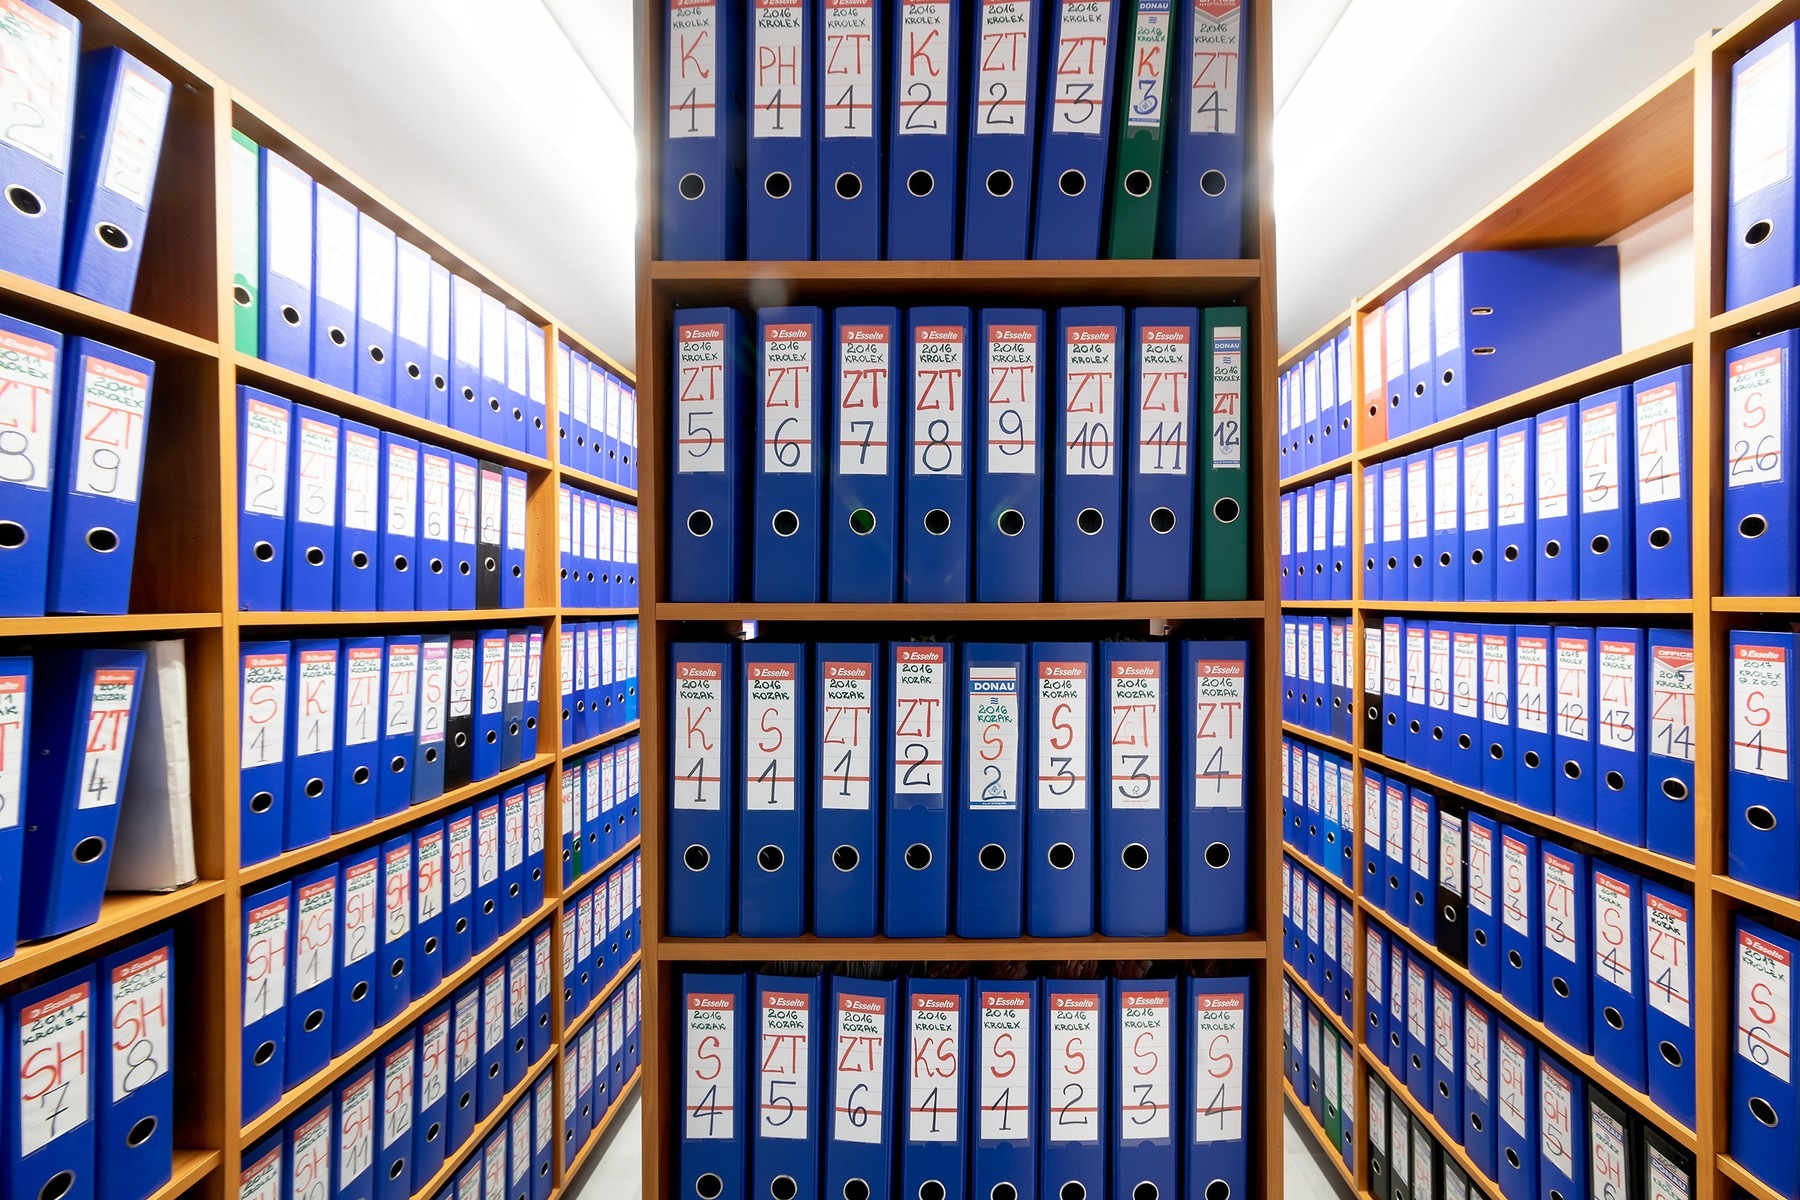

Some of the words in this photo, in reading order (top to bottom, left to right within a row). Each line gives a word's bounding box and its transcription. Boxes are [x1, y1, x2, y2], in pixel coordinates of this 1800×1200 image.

[759, 19, 800, 28] KROLEX
[763, 8, 792, 18] 2016
[987, 14, 1024, 24] KROLEX
[988, 4, 1015, 14] 2016
[1140, 2, 1169, 10] DONAU
[1138, 26, 1162, 36] 2016
[681, 30, 709, 79] K
[759, 46, 796, 86] PH
[827, 34, 870, 74] ZT
[910, 30, 940, 76] K
[982, 32, 1026, 71] ZT
[1058, 37, 1106, 74] ZT
[1138, 46, 1160, 77] K
[1192, 52, 1237, 90] ZT
[679, 87, 698, 132] 1
[766, 89, 784, 130] 1
[837, 84, 856, 129] 1
[906, 82, 937, 130] 2
[986, 82, 1014, 124] 2
[1064, 84, 1094, 124] 3
[1133, 80, 1158, 114] 3
[1198, 90, 1228, 132] 4
[847, 343, 878, 354] 2016
[855, 331, 883, 340] Esselte
[844, 354, 884, 363] KROLEX
[1214, 366, 1238, 374] 2016
[680, 365, 722, 401] ZT
[766, 366, 808, 408] ZT
[842, 368, 887, 408] ZT
[917, 369, 961, 411] ZT
[989, 366, 1034, 404] ZT
[1067, 372, 1112, 414] ZT
[1142, 372, 1187, 412] ZT
[1214, 374, 1240, 382] KROLEX
[87, 388, 144, 408] KROLEX
[1213, 392, 1239, 414] ZT
[1744, 392, 1766, 428] S
[85, 401, 142, 449] ZT
[688, 412, 713, 457] 5
[774, 418, 800, 467] 6
[850, 421, 874, 464] 7
[999, 409, 1024, 455] 9
[1213, 420, 1239, 446] 12
[1640, 417, 1675, 456] ZT
[0, 431, 34, 482] 8
[248, 432, 287, 472] ZT
[922, 419, 952, 471] 8
[1070, 422, 1109, 469] 10
[1146, 422, 1182, 469] 11
[1732, 435, 1778, 475] 26
[89, 449, 120, 493] 9
[1646, 456, 1670, 494] 4
[252, 474, 277, 511] 2
[902, 664, 932, 673] 2016
[910, 652, 938, 661] Esselte
[1484, 659, 1506, 684] ZT
[1748, 651, 1779, 659] Esselte
[306, 680, 327, 716] K
[427, 674, 440, 703] S
[901, 675, 932, 684] KOZAK
[974, 682, 1015, 691] DONAU
[1602, 674, 1632, 706] ZT
[249, 685, 277, 724] S
[426, 706, 438, 730] 2
[896, 698, 940, 738] ZT
[977, 714, 1012, 722] KOZAK
[978, 705, 1008, 714] 2016
[1197, 702, 1242, 739] ZT
[1485, 692, 1508, 720] 10
[1652, 691, 1694, 725] ZT
[1744, 691, 1771, 726] S
[86, 710, 129, 752] ZT
[250, 726, 268, 762] 1
[308, 719, 320, 752] 1
[687, 706, 713, 750] K
[759, 708, 783, 752] S
[824, 706, 871, 746] ZT
[980, 724, 1004, 760] S
[1050, 703, 1074, 750] S
[1112, 704, 1156, 748] ZT
[1603, 710, 1634, 742] 13
[1658, 724, 1695, 758] 14
[903, 744, 931, 786] 2
[1747, 730, 1763, 770] 1
[88, 759, 107, 801] 4
[687, 758, 706, 802] 1
[758, 759, 778, 804] 1
[834, 750, 851, 796] 1
[982, 765, 1008, 801] 2
[1048, 757, 1076, 795] 3
[1118, 754, 1151, 799] 3
[1203, 746, 1230, 793] 4
[419, 856, 441, 892] SH
[450, 838, 471, 873] SH
[453, 871, 466, 897] 5
[1507, 865, 1521, 893] S
[347, 888, 375, 929] SH
[422, 895, 435, 918] 4
[1508, 894, 1522, 921] 3
[1547, 880, 1574, 917] ZT
[1657, 903, 1682, 918] Esselte
[299, 909, 332, 955] KS
[351, 926, 367, 961] 2
[1551, 917, 1565, 942] 3
[1602, 908, 1623, 945] S
[247, 930, 286, 981] SH
[1649, 926, 1685, 966] ZT
[1752, 942, 1784, 960] Esselte
[120, 966, 156, 989] 2011
[306, 949, 320, 983] 1
[1602, 948, 1624, 983] 4
[114, 972, 167, 999] KROLEX
[255, 978, 270, 1017] 1
[776, 998, 804, 1007] Esselte
[1656, 967, 1679, 1003] 4
[1748, 983, 1776, 1024] S
[23, 1011, 88, 1045] KROLEX
[32, 1006, 74, 1032] 2011
[113, 988, 165, 1051] SH
[768, 1009, 798, 1019] 2016
[768, 1020, 804, 1028] KOZAK
[695, 1036, 722, 1080] S
[762, 1034, 806, 1074] ZT
[838, 1036, 882, 1072] ZT
[914, 1037, 957, 1078] KS
[991, 1032, 1016, 1078] S
[1064, 1037, 1085, 1075] S
[1133, 1032, 1158, 1076] S
[1208, 1034, 1233, 1078] S
[1748, 1027, 1771, 1065] 6
[22, 1030, 84, 1101] SH
[123, 1039, 158, 1093] 8
[41, 1082, 70, 1137] 7
[386, 1068, 412, 1114] SH
[692, 1084, 723, 1136] 4
[766, 1080, 796, 1126] 5
[848, 1083, 868, 1127] 6
[920, 1087, 940, 1132] 1
[991, 1088, 1011, 1130] 1
[1059, 1083, 1088, 1125] 2
[1131, 1084, 1157, 1125] 3
[1204, 1083, 1232, 1130] 4
[343, 1098, 371, 1149] SH
[389, 1103, 408, 1140] 12
[1544, 1091, 1568, 1132] SH
[346, 1135, 368, 1175] 11
[1548, 1123, 1562, 1156] 5
[1652, 1158, 1687, 1190] DONAU
